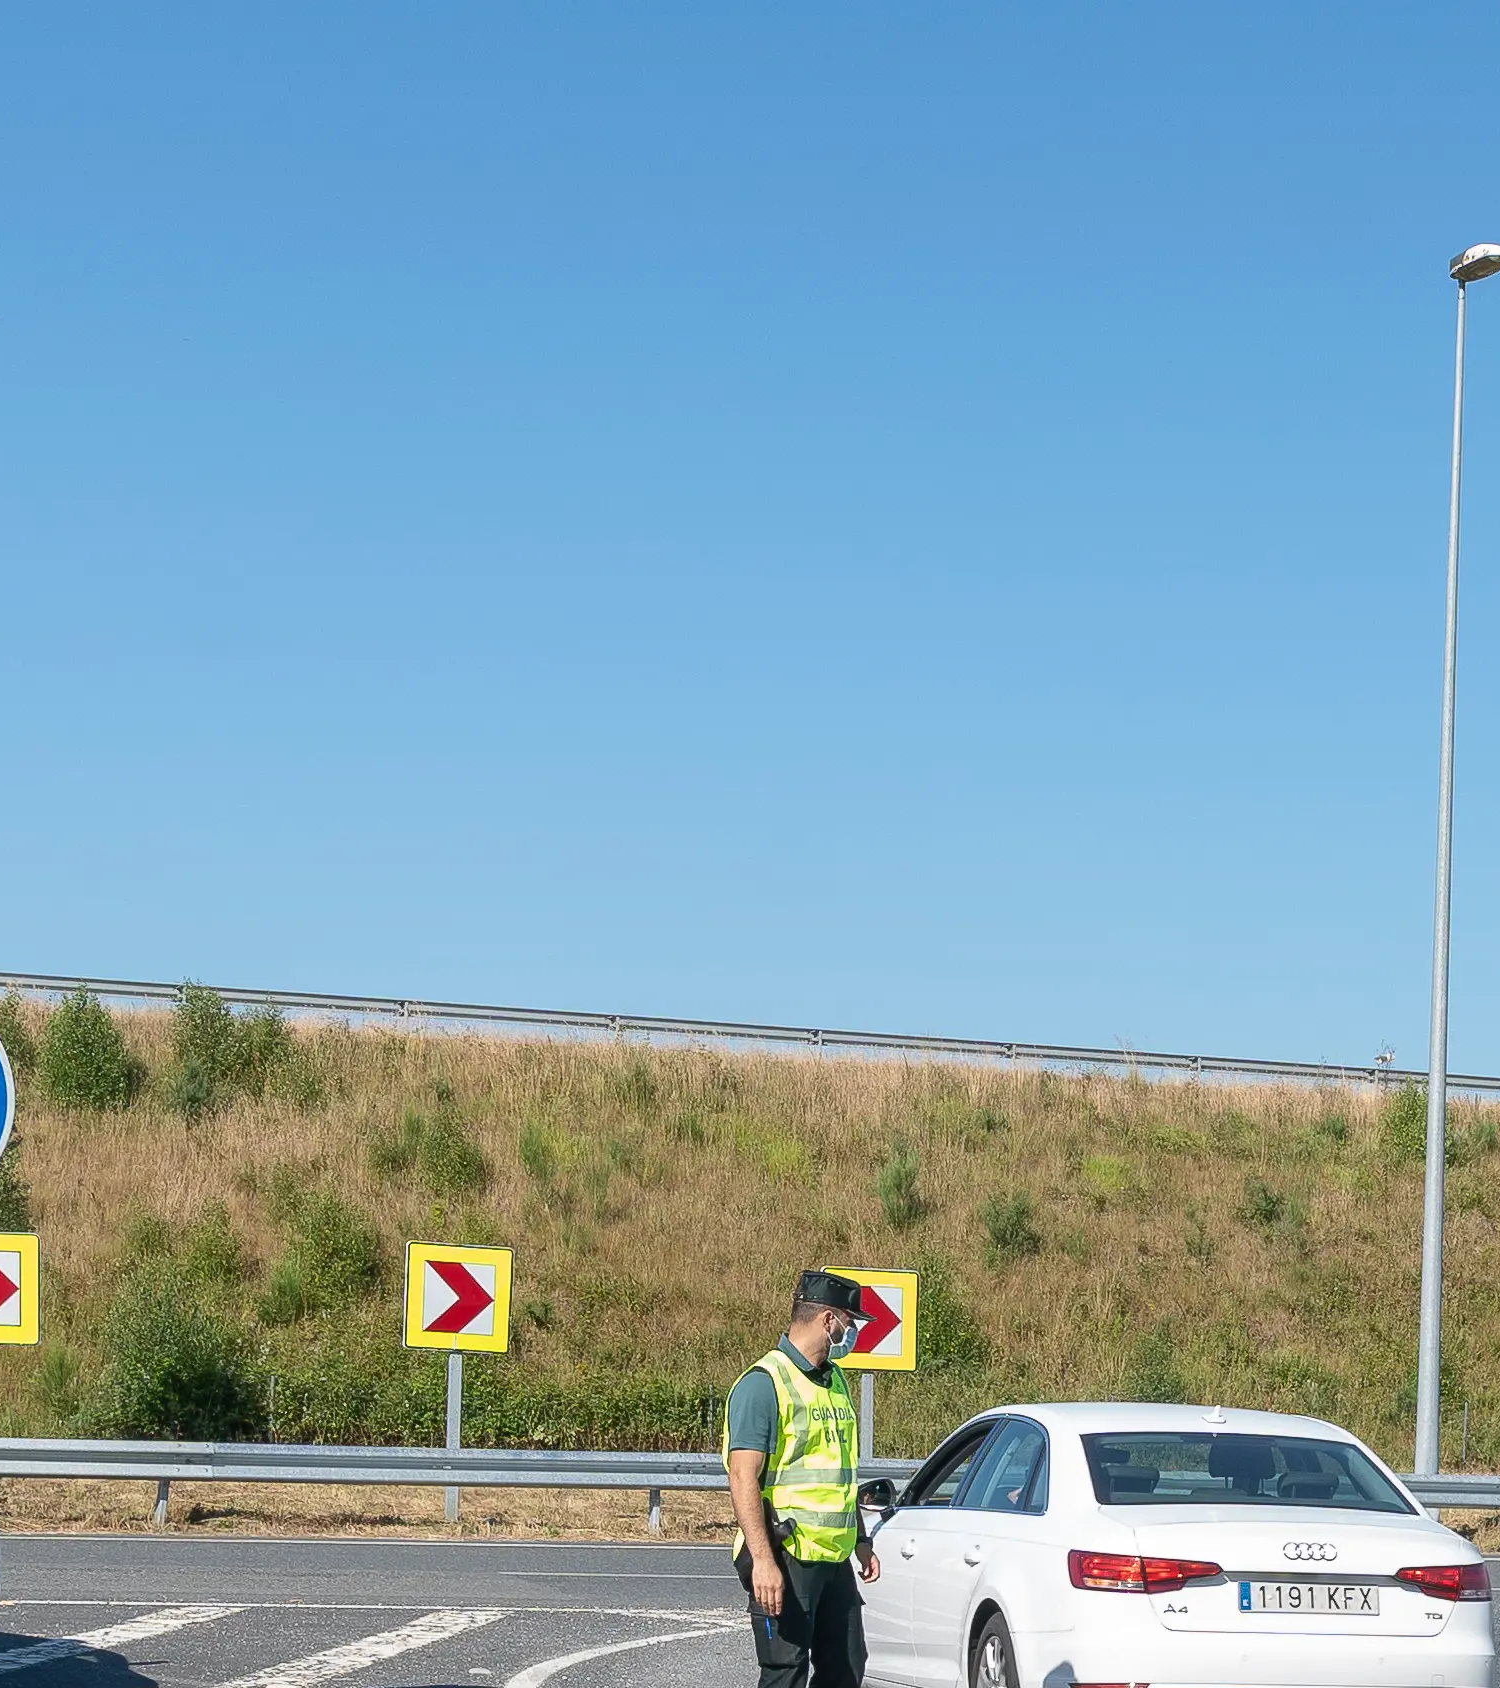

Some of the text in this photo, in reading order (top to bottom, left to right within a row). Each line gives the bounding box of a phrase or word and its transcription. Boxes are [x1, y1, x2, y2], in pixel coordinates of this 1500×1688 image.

[1259, 1585, 1373, 1611] 1191 KFX
[1163, 1603, 1189, 1614] A4
[1424, 1612, 1443, 1620] TDI
